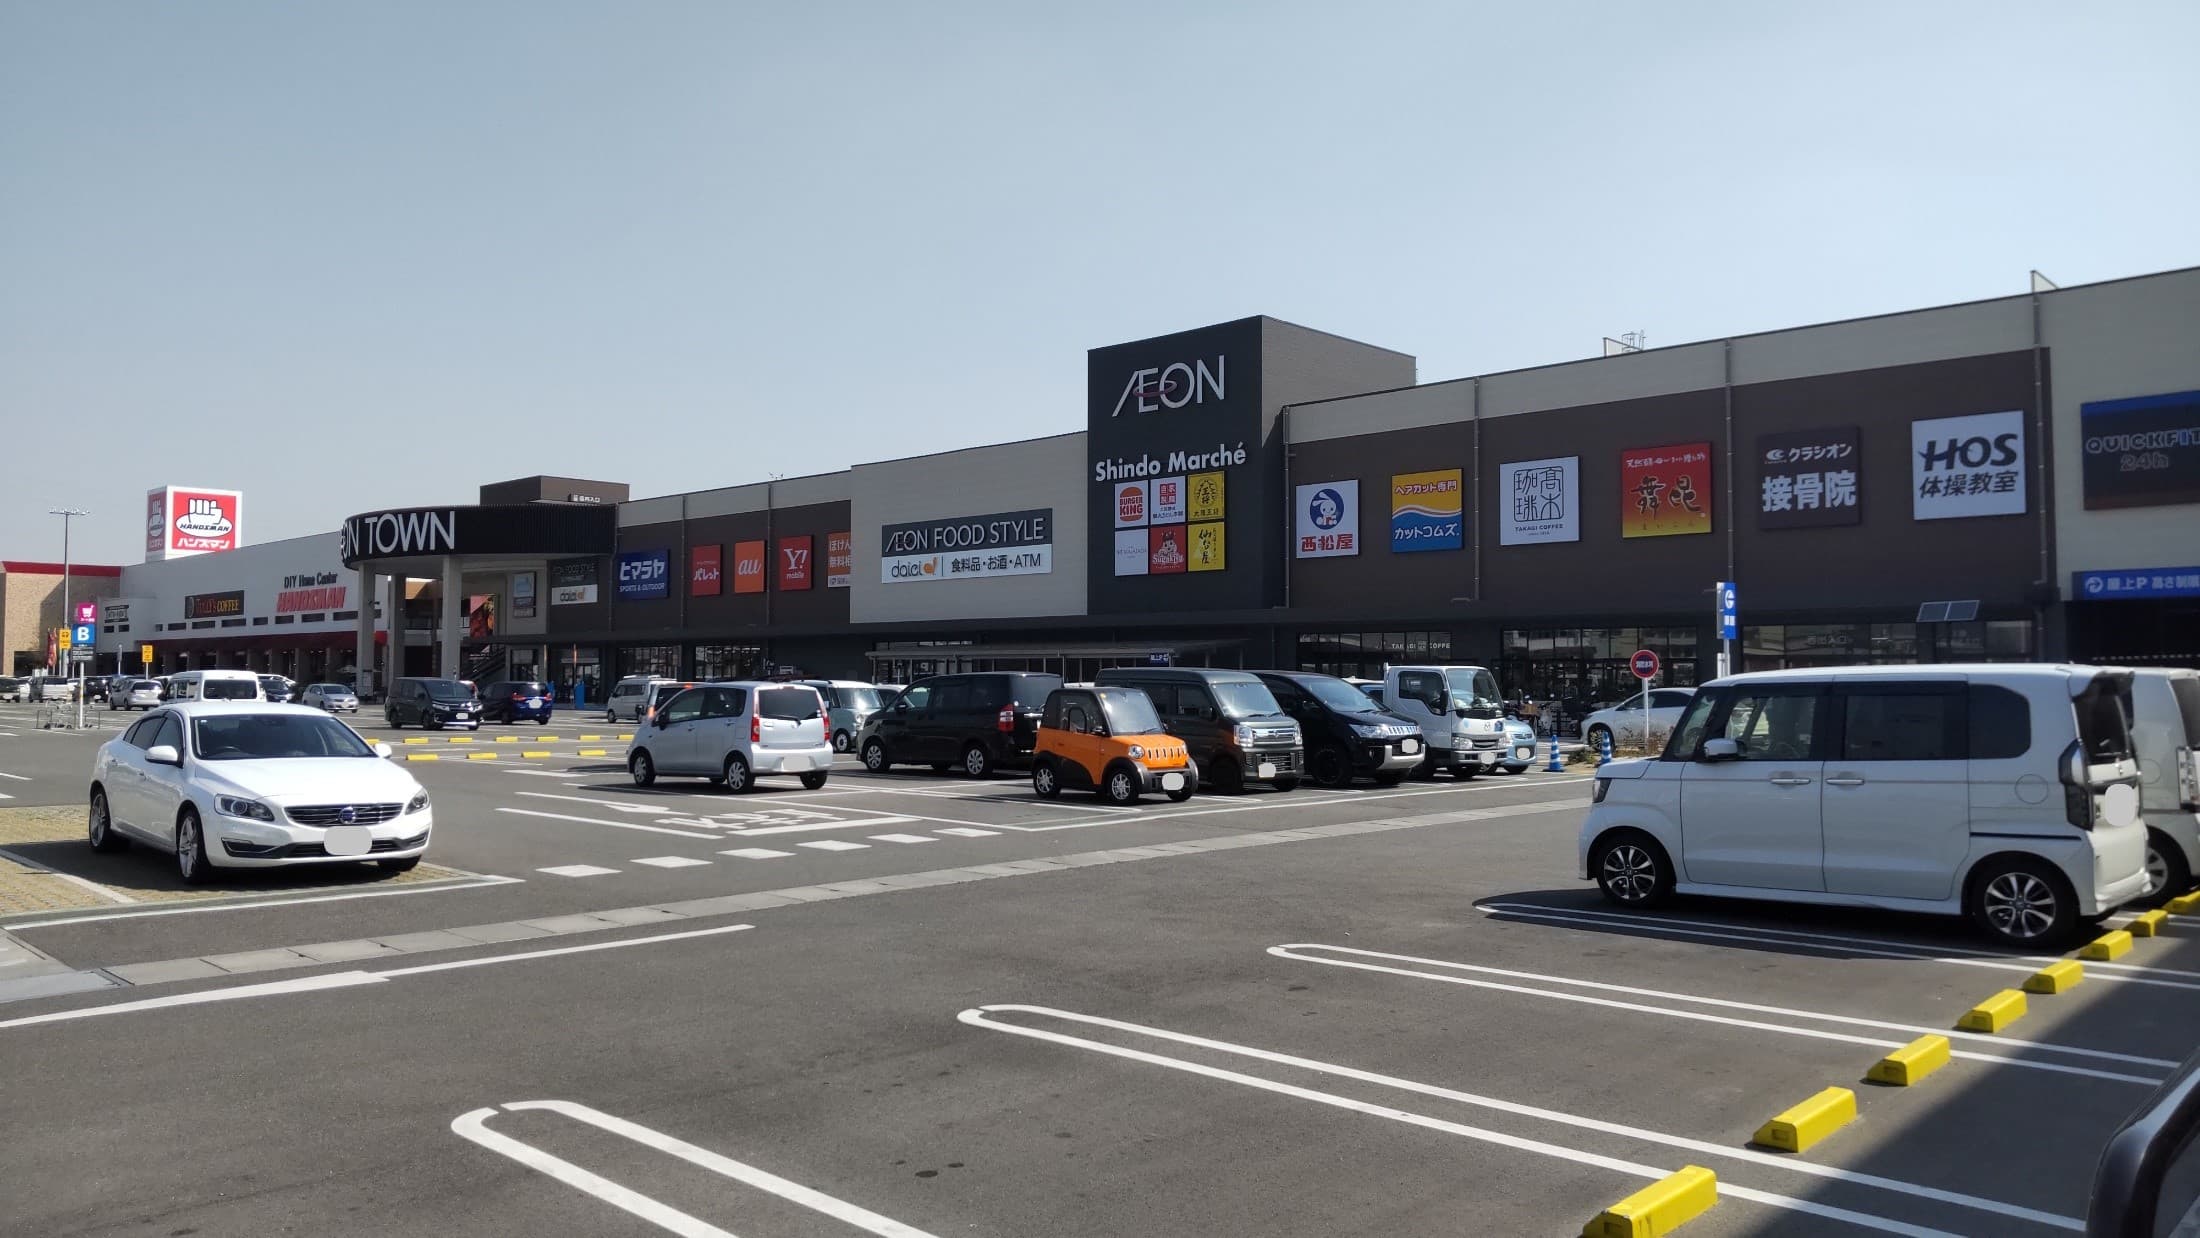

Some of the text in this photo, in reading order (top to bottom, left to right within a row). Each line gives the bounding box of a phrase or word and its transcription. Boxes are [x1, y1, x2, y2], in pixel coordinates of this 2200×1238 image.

[1095, 442, 1247, 482] Shindo Marché
[1789, 443, 1852, 463] クラシオン
[1918, 433, 2018, 472] HOS
[2120, 452, 2169, 472] 24h
[1395, 480, 1457, 495] ヘアカット専門
[1762, 469, 1857, 512] 接骨院
[1919, 471, 2019, 499] 体操教室
[1120, 496, 1143, 505] BURGER
[1120, 504, 1143, 516] KING
[180, 523, 230, 532] HANDSMAN
[365, 511, 455, 554] TOWN
[934, 524, 985, 548] FOOD
[990, 518, 1044, 544] STYLE
[1301, 533, 1353, 552] 西松屋
[620, 559, 665, 580] ヒマラヤ
[738, 560, 761, 575] au
[784, 549, 808, 570] Y!
[284, 576, 297, 589] DIY
[217, 600, 239, 613] COFFEE
[77, 627, 89, 641] B
